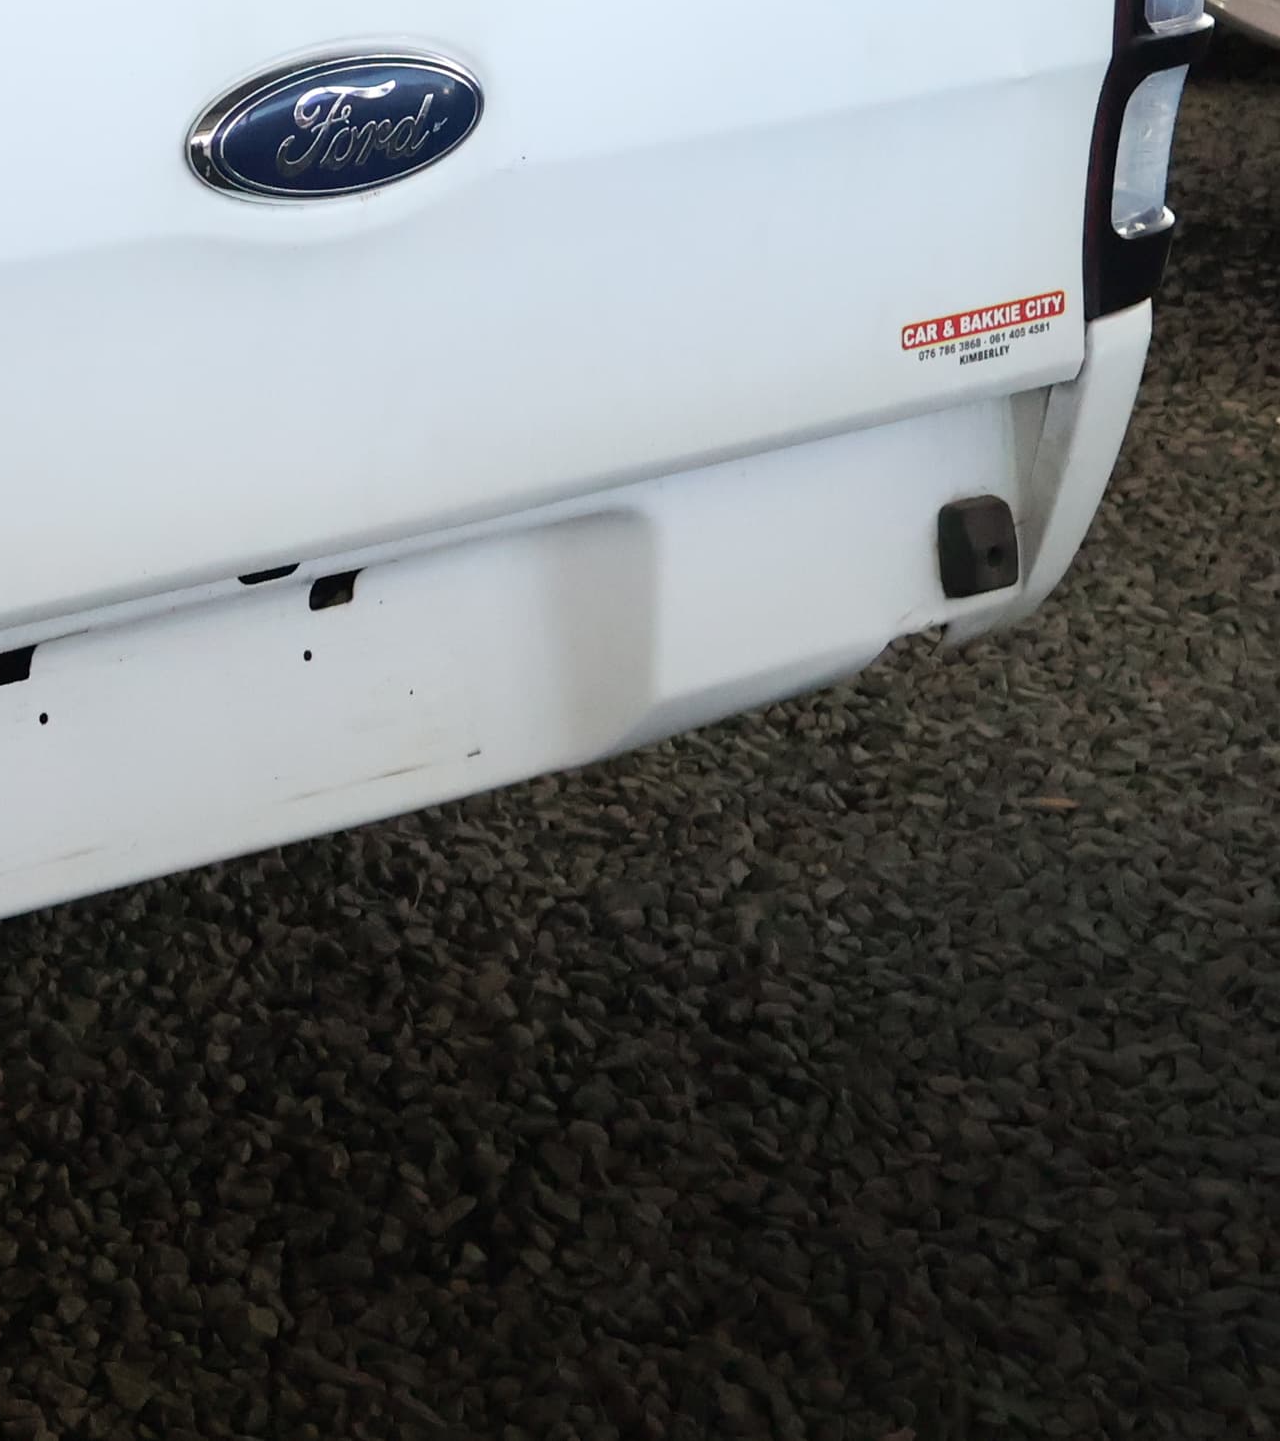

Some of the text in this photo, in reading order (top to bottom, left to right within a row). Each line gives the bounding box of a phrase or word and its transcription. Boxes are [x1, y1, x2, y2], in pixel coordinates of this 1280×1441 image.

[276, 79, 447, 178] Ford
[903, 294, 1062, 348] CAR & BAKKIE CITY
[918, 348, 936, 362] 076
[940, 343, 956, 357] 786
[959, 338, 982, 352] 3868
[1028, 321, 1051, 335] 4581
[959, 345, 1011, 366] KIMBERLEY
